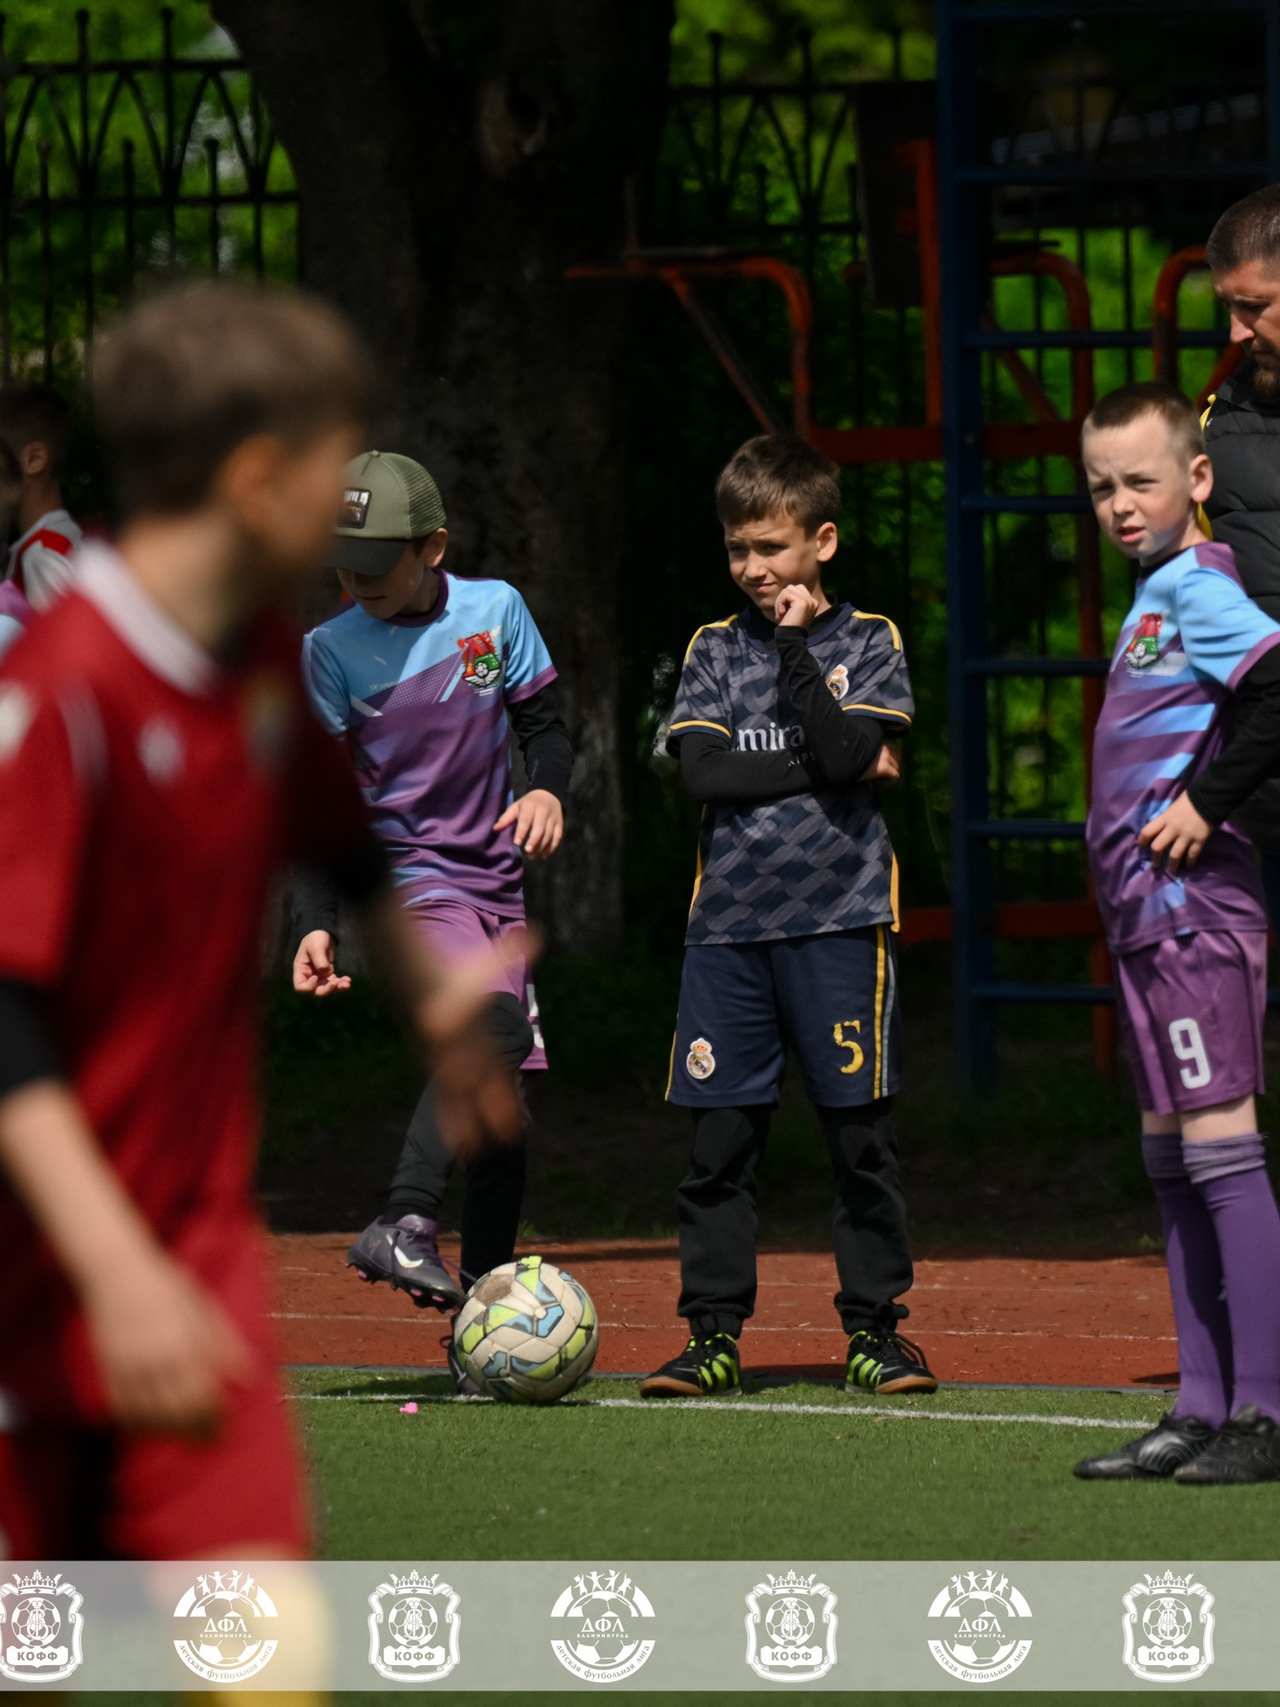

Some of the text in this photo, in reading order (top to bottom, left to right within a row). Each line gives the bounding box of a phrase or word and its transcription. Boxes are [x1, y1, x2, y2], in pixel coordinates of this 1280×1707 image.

[731, 721, 806, 752] mira
[832, 1019, 865, 1075] 5
[1168, 1016, 1212, 1090] 9
